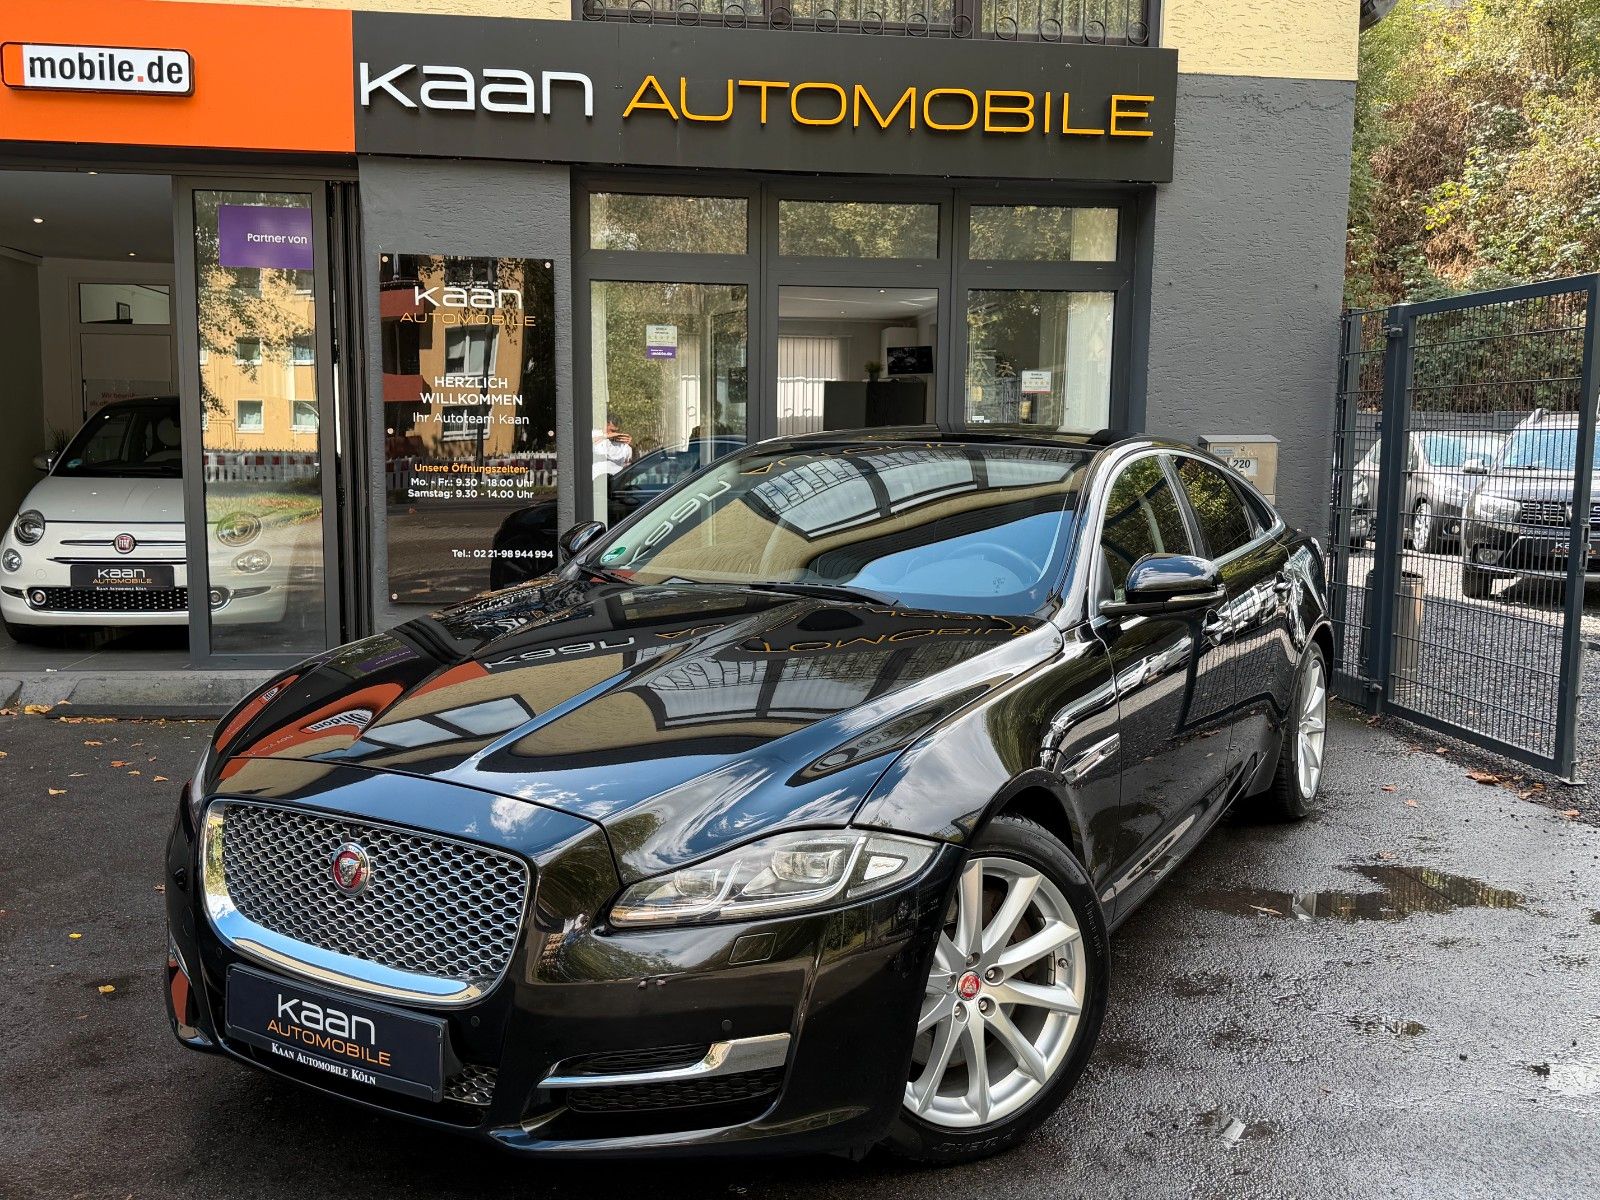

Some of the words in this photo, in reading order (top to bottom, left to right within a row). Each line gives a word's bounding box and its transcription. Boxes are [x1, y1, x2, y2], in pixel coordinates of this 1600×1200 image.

[29, 52, 183, 84] mobile.de
[623, 75, 1154, 137] AUTOMOBILE
[247, 233, 286, 243] Partner
[287, 236, 308, 244] von
[400, 312, 536, 327] AUTOMOBILE
[434, 376, 508, 389] HERZLICH
[420, 392, 523, 406] WILLKOMMEN
[413, 412, 429, 423] Ihr
[433, 412, 495, 424] Autoteam
[499, 414, 530, 425] Kaan
[414, 463, 449, 472] Unsere
[451, 463, 529, 475] Öffnungszeiten:
[411, 478, 429, 486] Mo.
[456, 478, 478, 487] 9.30
[487, 479, 514, 487] 18.00
[516, 479, 534, 487] Uhr
[408, 489, 453, 499] Samstag:
[456, 489, 478, 498] 9.30
[487, 490, 514, 498] 14.00
[517, 490, 534, 498] Uhr
[452, 549, 471, 558] Tel.:
[267, 1019, 391, 1067] AUTOMOBILE
